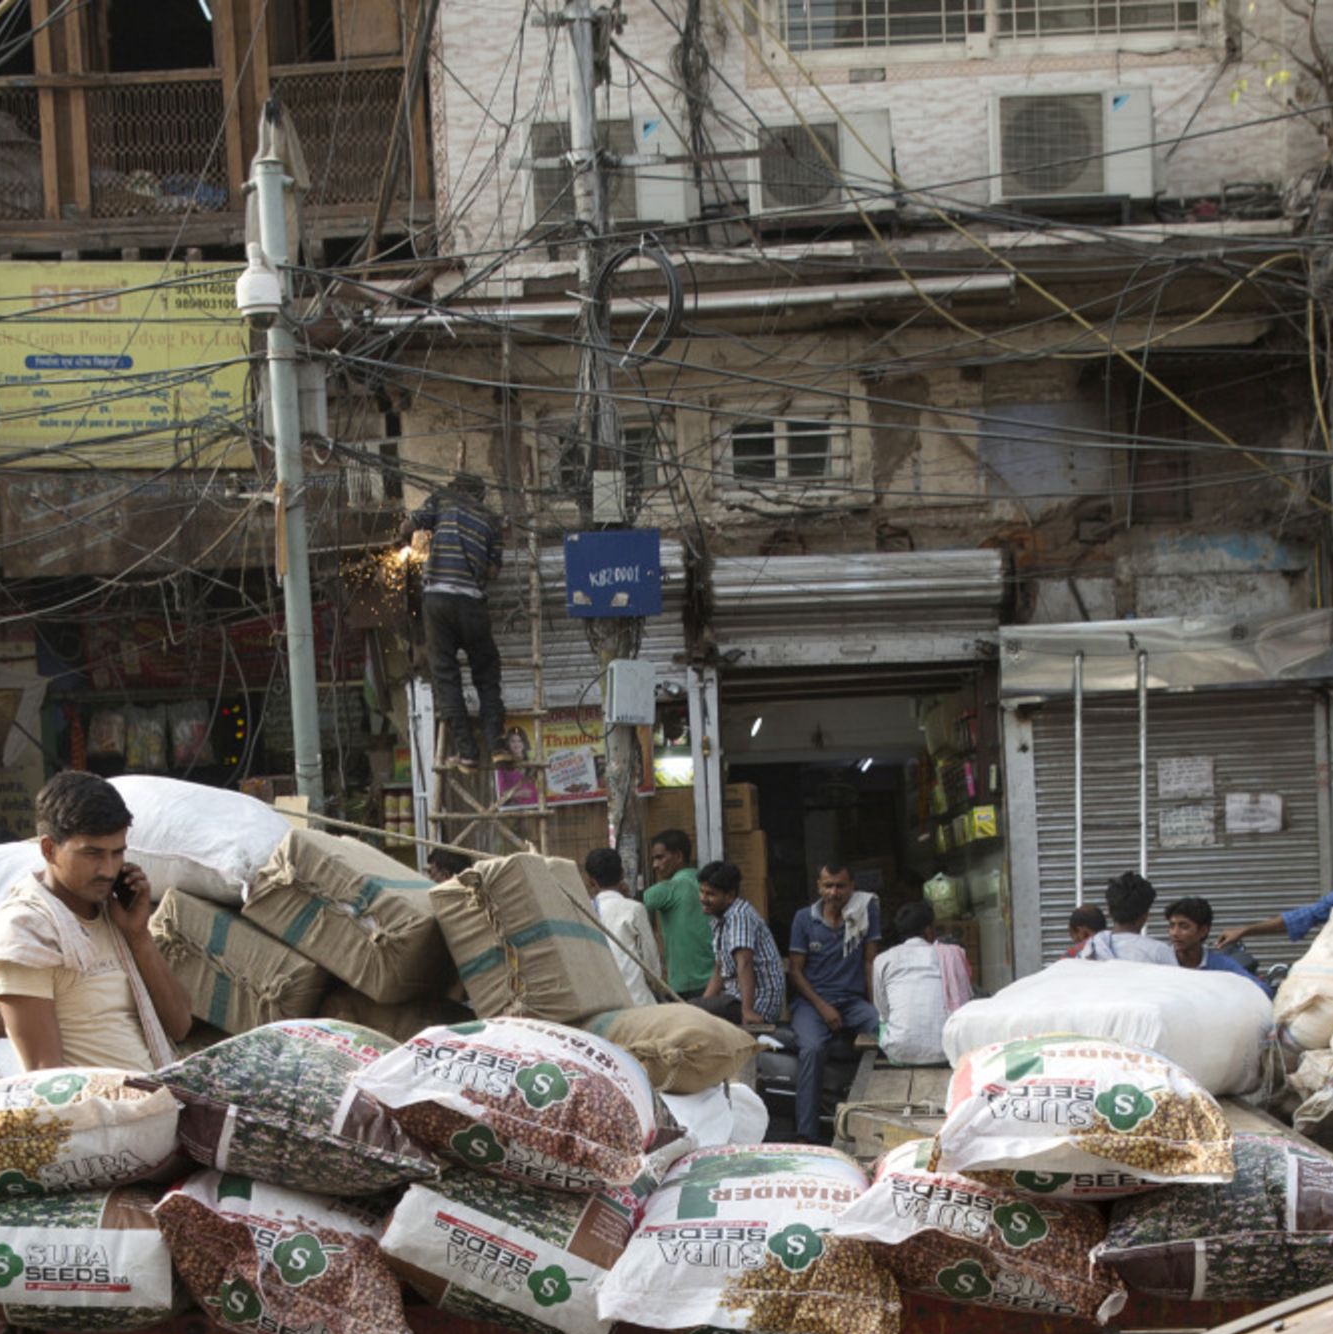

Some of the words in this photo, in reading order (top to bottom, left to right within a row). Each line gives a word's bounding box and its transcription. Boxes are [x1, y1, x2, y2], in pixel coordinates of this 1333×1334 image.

[532, 1073, 555, 1096] S
[1114, 1094, 1135, 1115] S
[470, 1138, 490, 1158] S
[657, 1227, 767, 1242] SEEDS
[1009, 1212, 1031, 1234] S
[25, 1244, 109, 1267] SUBA
[449, 1227, 533, 1276] SEEDS
[658, 1240, 766, 1269] SUBA
[786, 1233, 808, 1256] S
[288, 1247, 311, 1270] S
[446, 1242, 525, 1293] SUBA
[25, 1266, 110, 1284] SEEDS
[954, 1274, 976, 1293] S
[539, 1277, 560, 1298] S
[227, 1290, 249, 1313] S
